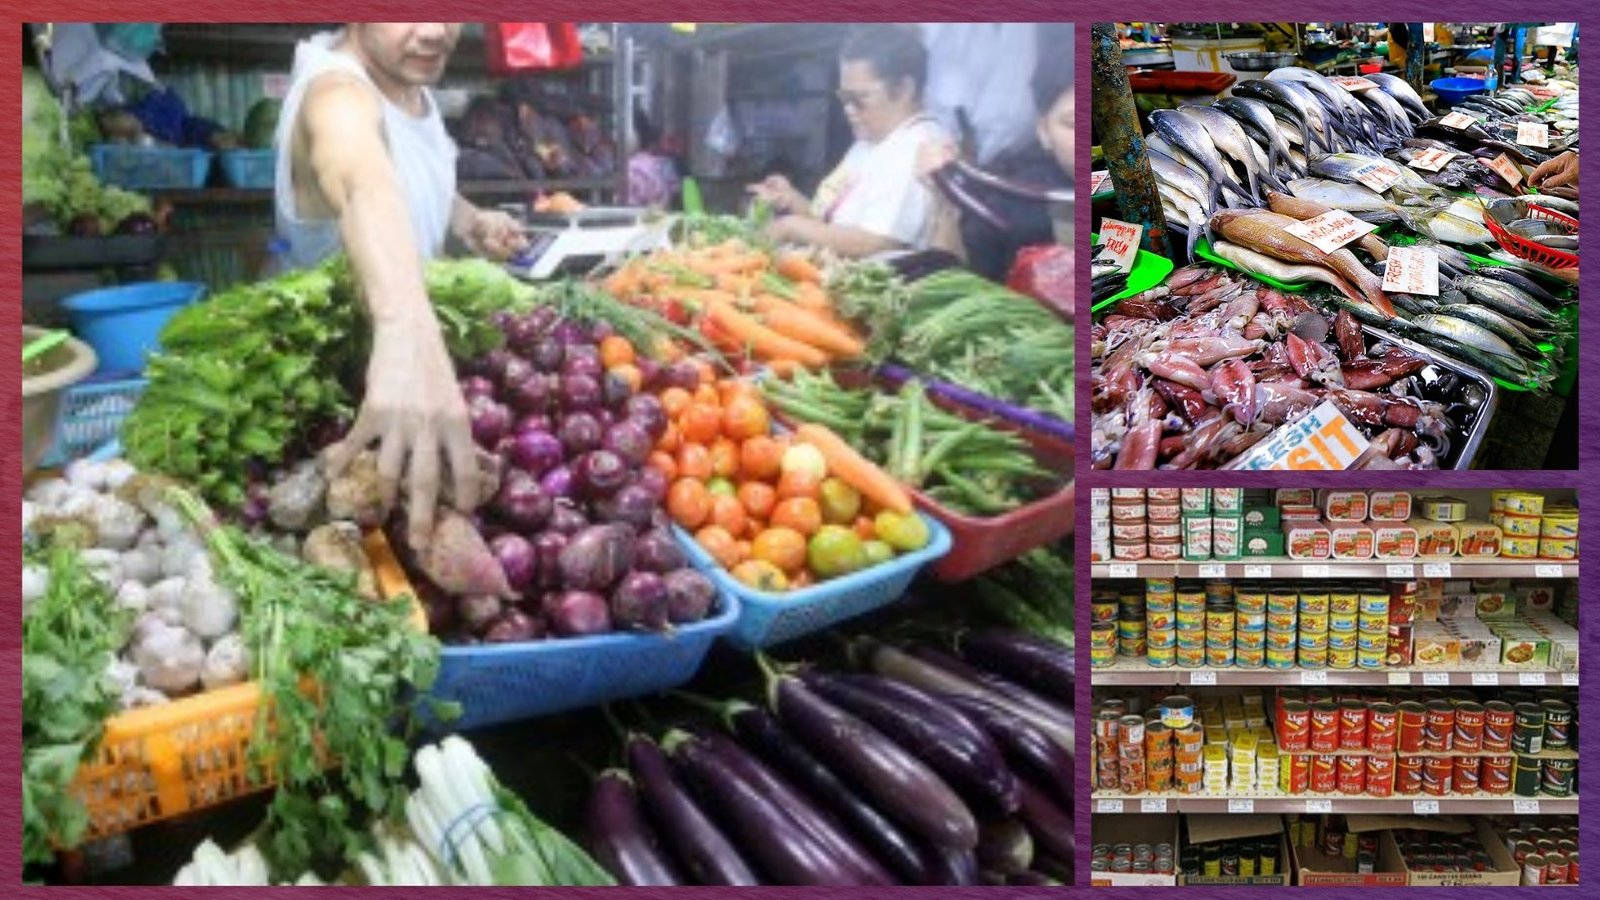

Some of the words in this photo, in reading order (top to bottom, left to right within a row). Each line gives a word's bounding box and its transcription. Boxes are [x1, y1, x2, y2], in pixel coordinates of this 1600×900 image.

[1271, 415, 1360, 470] SIT
[1287, 714, 1308, 726] Ligo
[1313, 712, 1334, 725] Ligo
[1343, 711, 1364, 723] Ligo
[1374, 714, 1395, 727] Ligo
[1456, 712, 1479, 724] Ligo
